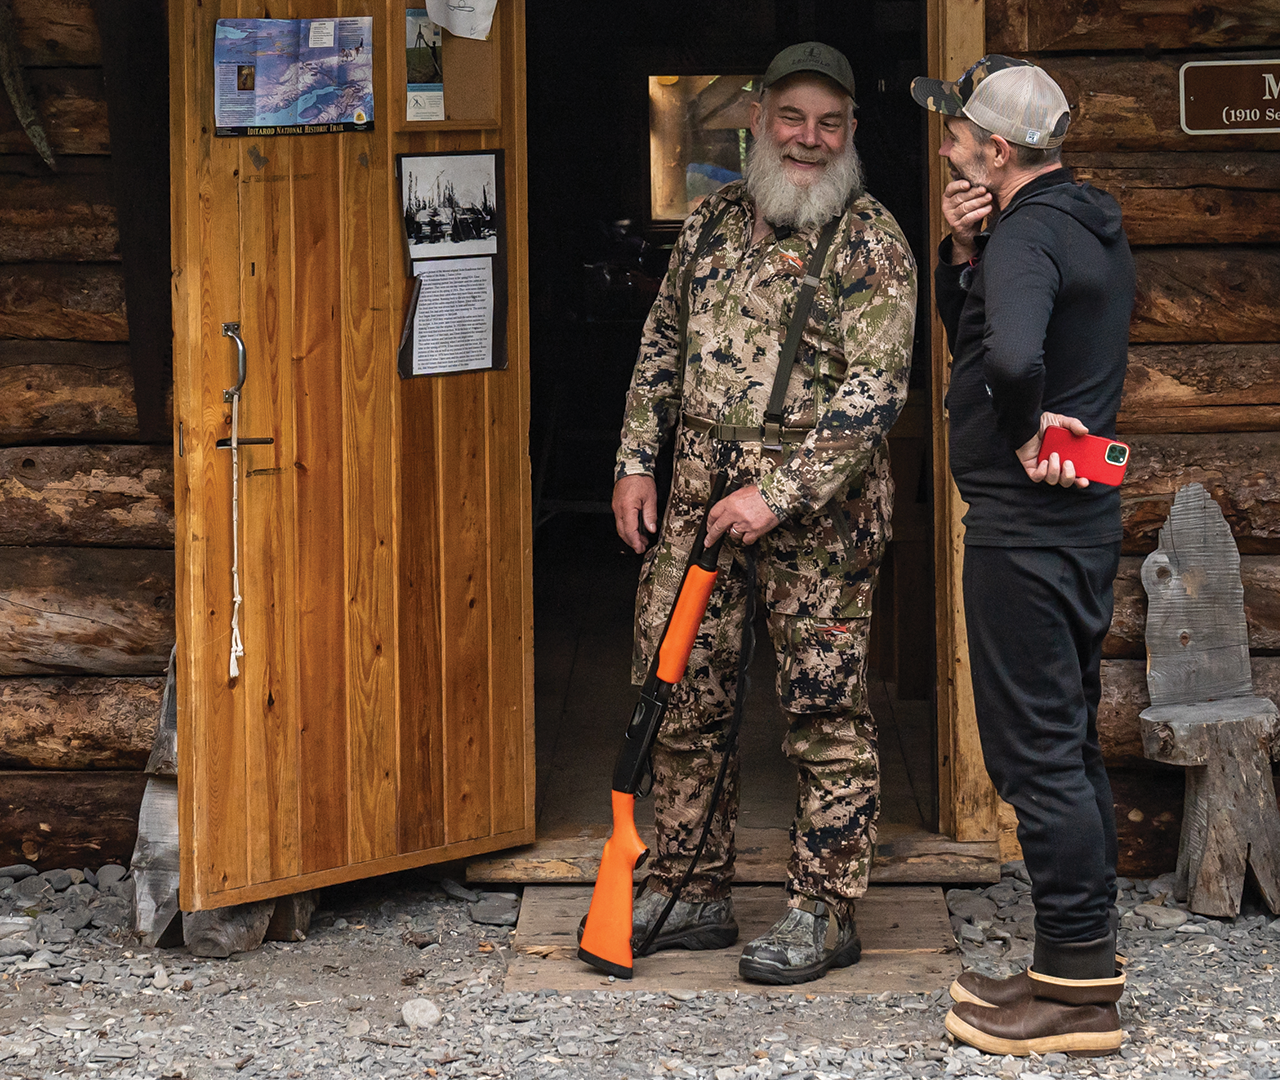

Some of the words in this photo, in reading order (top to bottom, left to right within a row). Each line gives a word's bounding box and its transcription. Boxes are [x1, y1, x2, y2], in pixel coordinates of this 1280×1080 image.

[1222, 106, 1260, 125] (1910
[247, 126, 275, 136] IDITAROD
[276, 125, 303, 135] NATIONAL
[304, 124, 329, 133] HISTORIC
[330, 123, 344, 132] TRAIL
